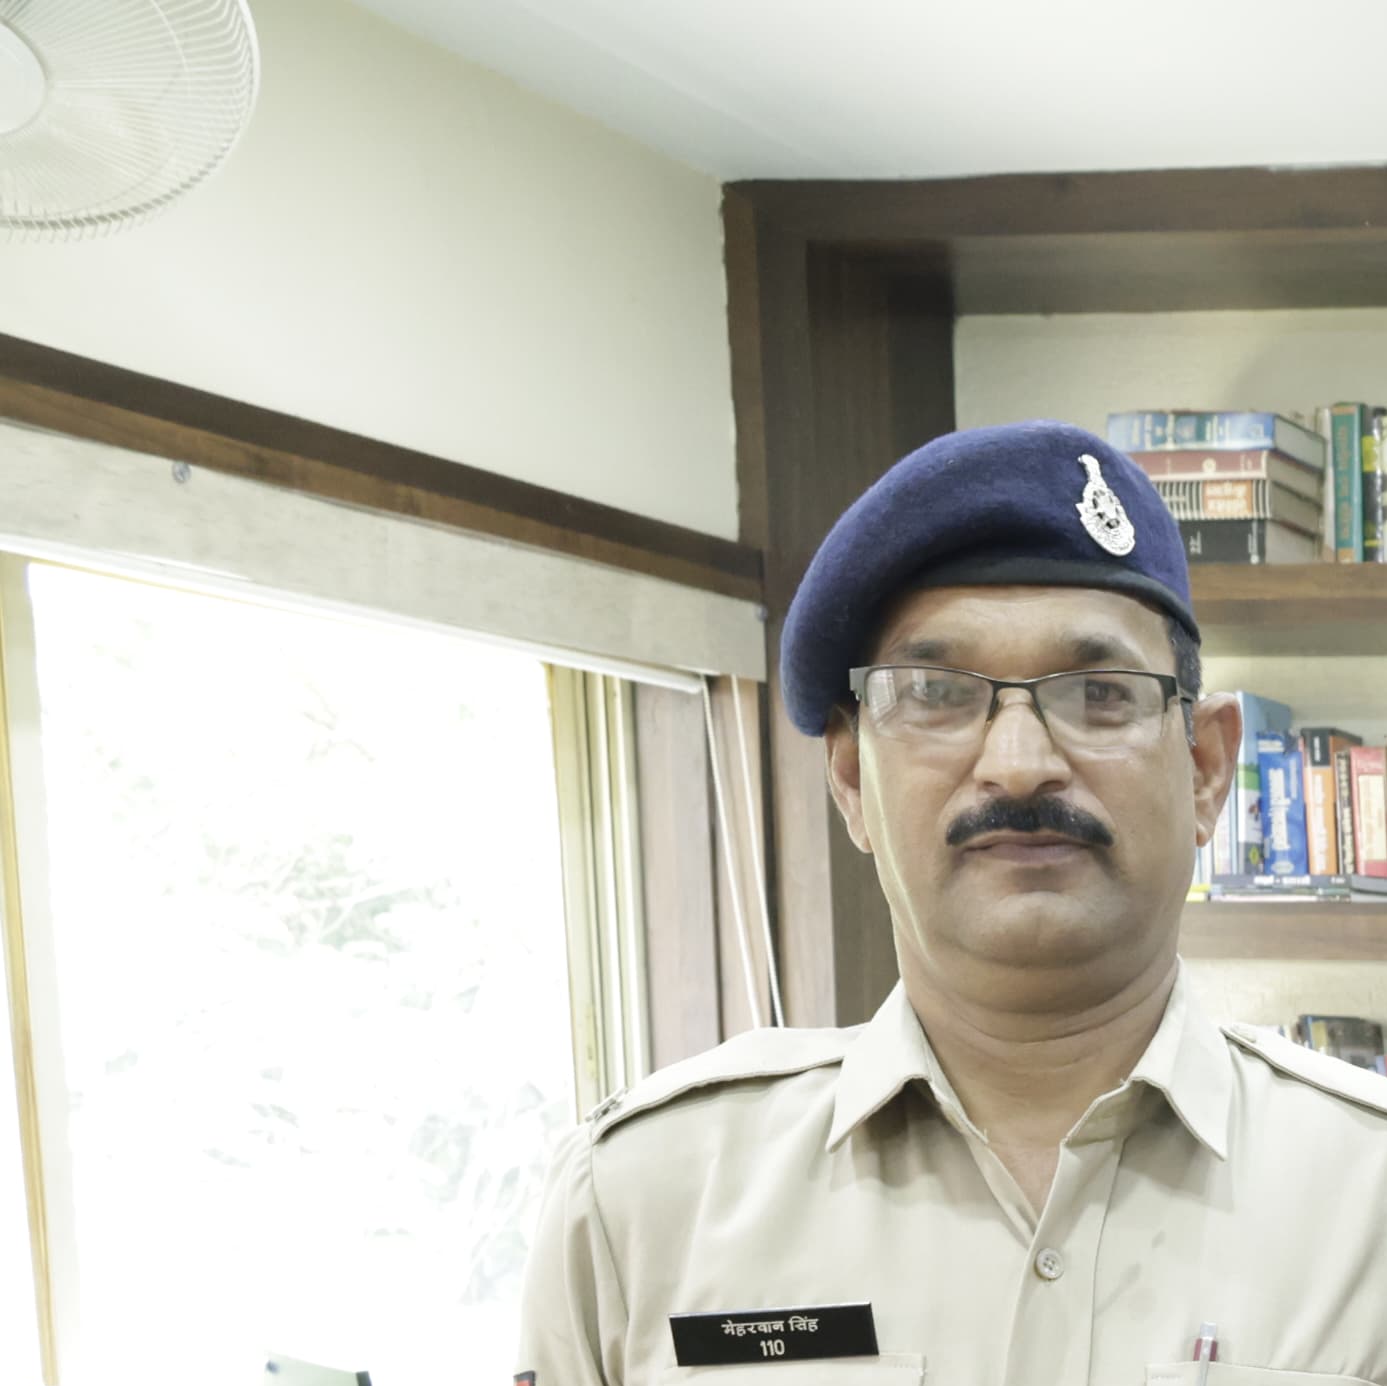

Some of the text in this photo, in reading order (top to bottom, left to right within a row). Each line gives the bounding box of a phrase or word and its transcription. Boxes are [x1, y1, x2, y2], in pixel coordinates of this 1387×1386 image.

[721, 1316, 819, 1336] मेहरवान सिंह
[760, 1339, 785, 1356] 110
